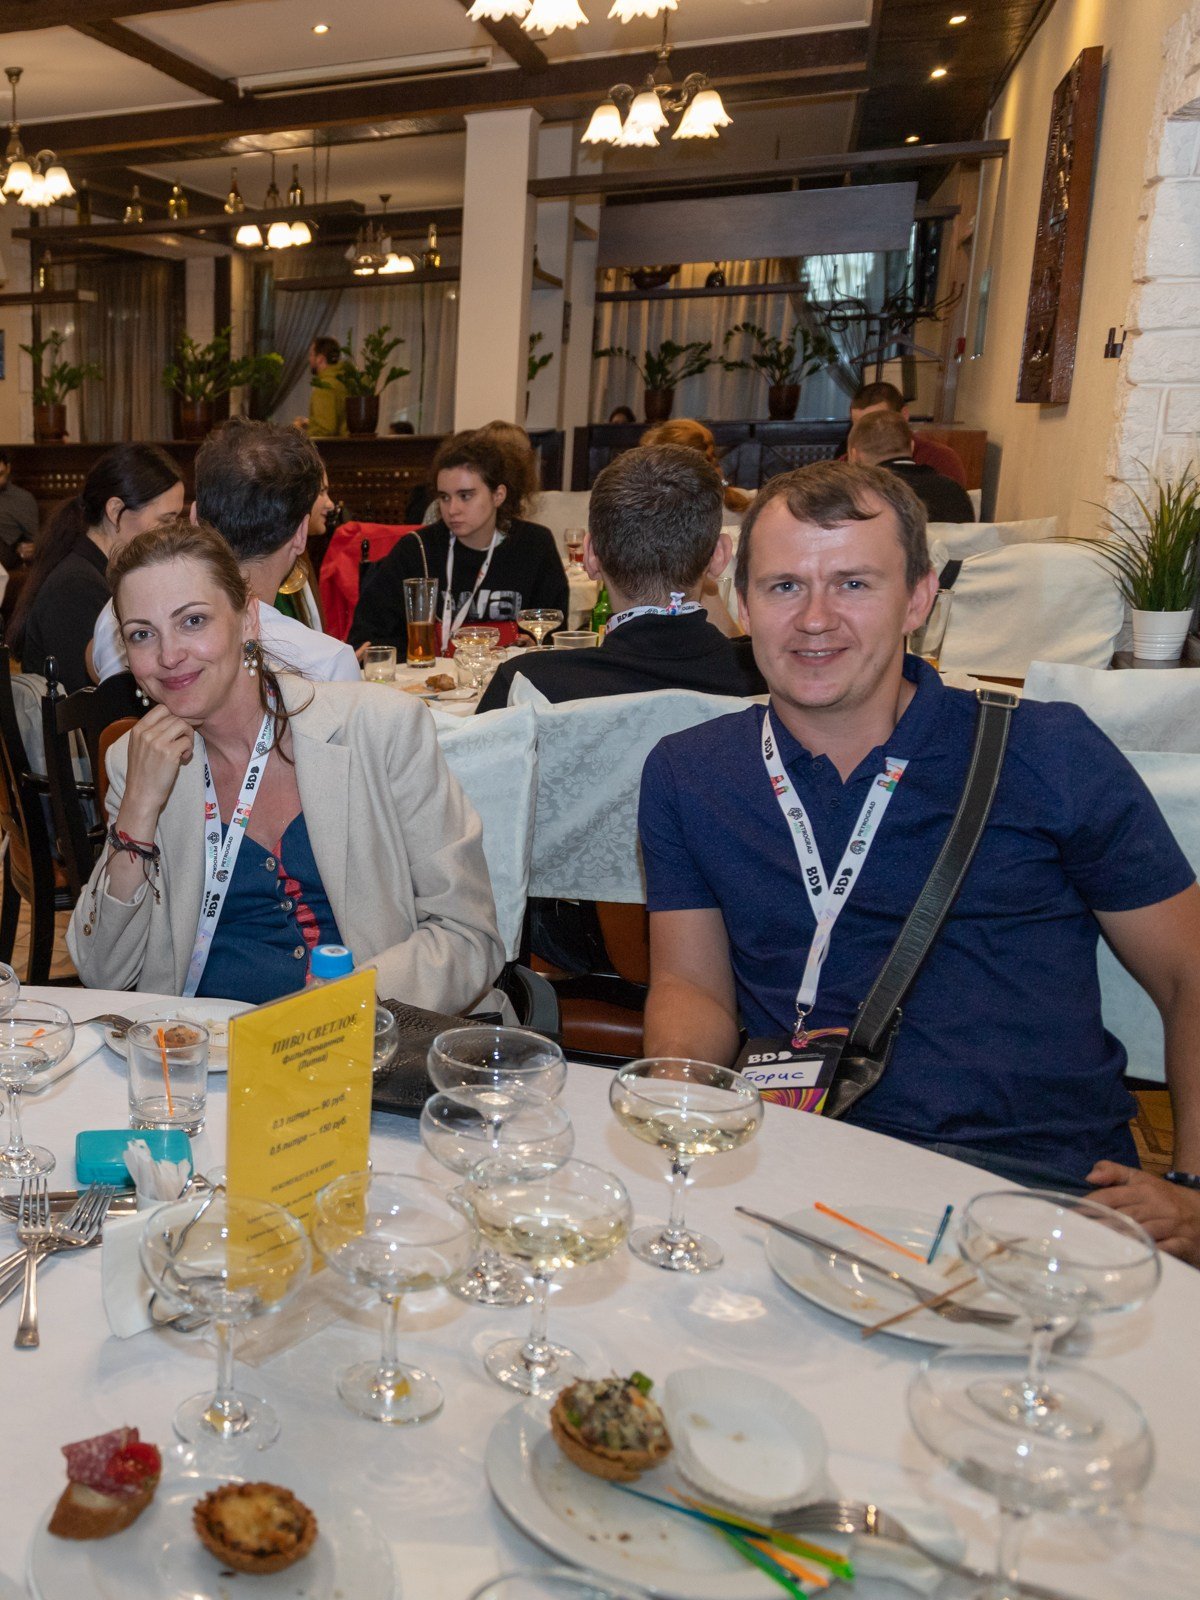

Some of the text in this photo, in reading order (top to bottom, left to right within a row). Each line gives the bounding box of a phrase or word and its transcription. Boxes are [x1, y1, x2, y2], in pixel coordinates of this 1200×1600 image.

[245, 765, 260, 790] BDD
[857, 801, 876, 837] PETROGRAD
[798, 820, 813, 854] PETROGRAD
[221, 836, 234, 867] PETROGRAD
[806, 866, 823, 896] BDD
[833, 867, 853, 895] BDD
[206, 893, 221, 917] BDD
[271, 1032, 306, 1055] ПИВО
[747, 1050, 793, 1064] BDD
